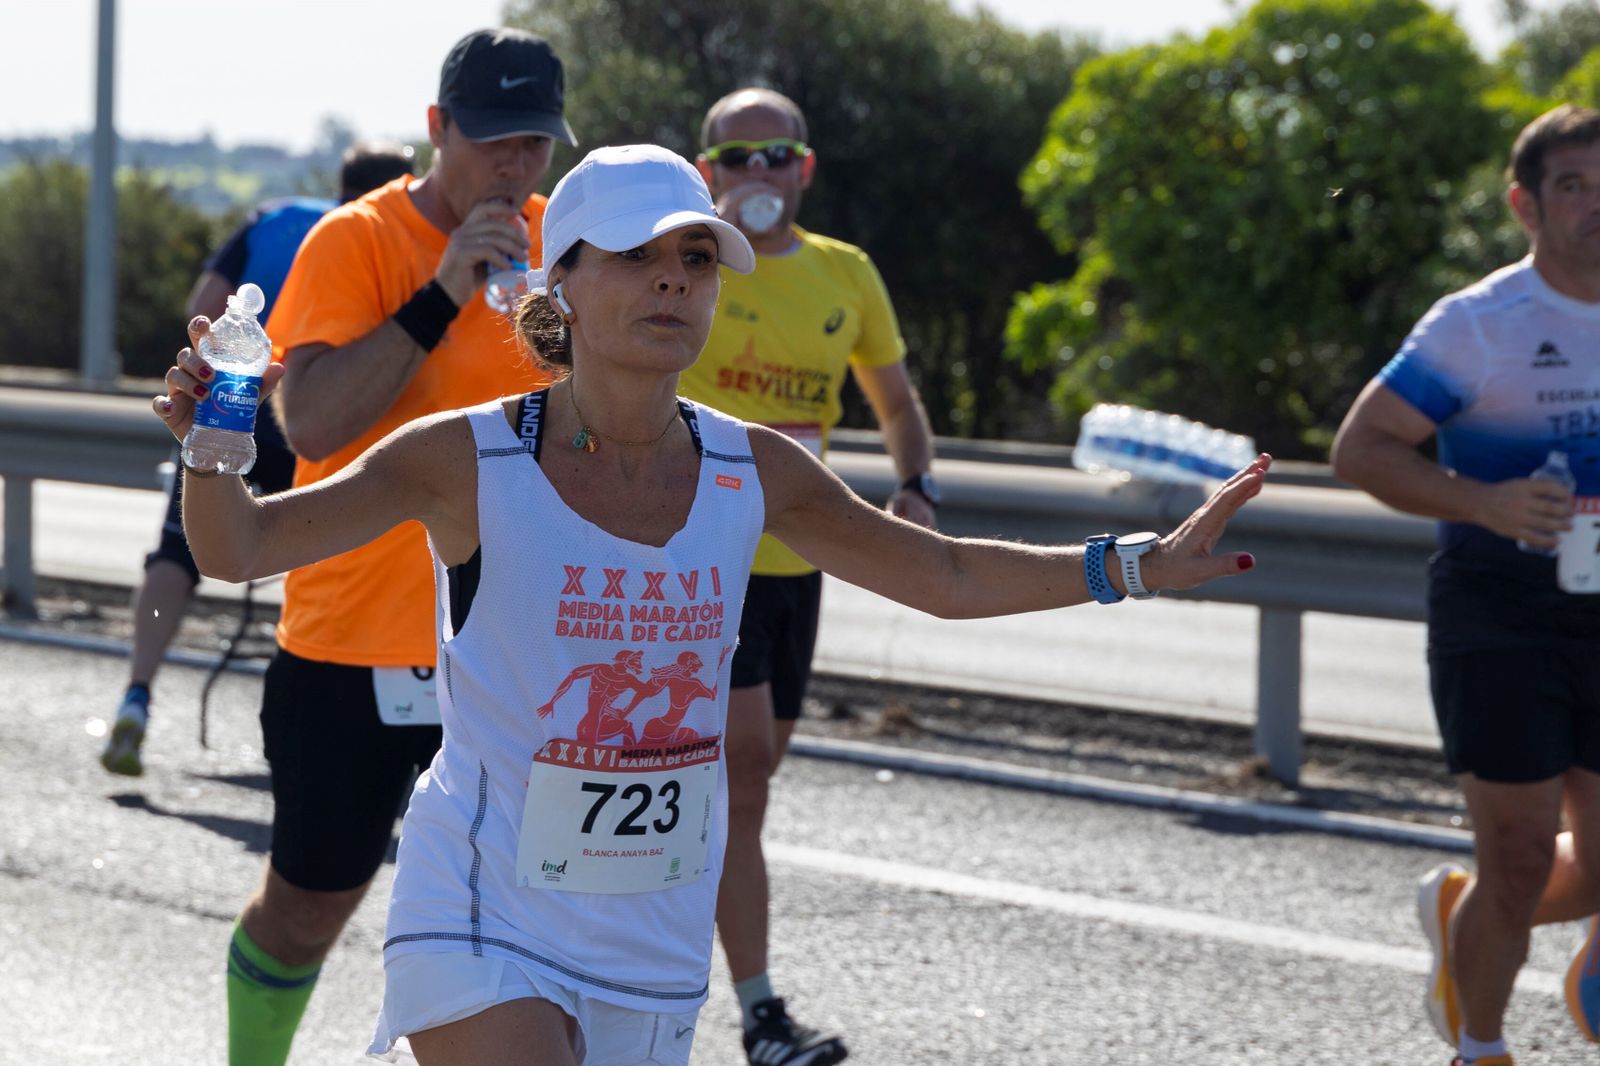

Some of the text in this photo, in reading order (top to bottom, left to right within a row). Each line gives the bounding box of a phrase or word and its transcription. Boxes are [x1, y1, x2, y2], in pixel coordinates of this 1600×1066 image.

[718, 367, 827, 403] SEVILLA
[520, 395, 542, 458] UNDE
[561, 565, 721, 601] XXXVI
[558, 599, 724, 623] MEDIA MARATÓN
[555, 620, 724, 642] BAHÍA DE CÁDIZ
[620, 748, 663, 759] MEDIA
[666, 754, 681, 766] DE
[580, 780, 682, 836] 723
[582, 847, 664, 858] BLANCA ANAYA BAZ
[541, 859, 568, 875] imd
